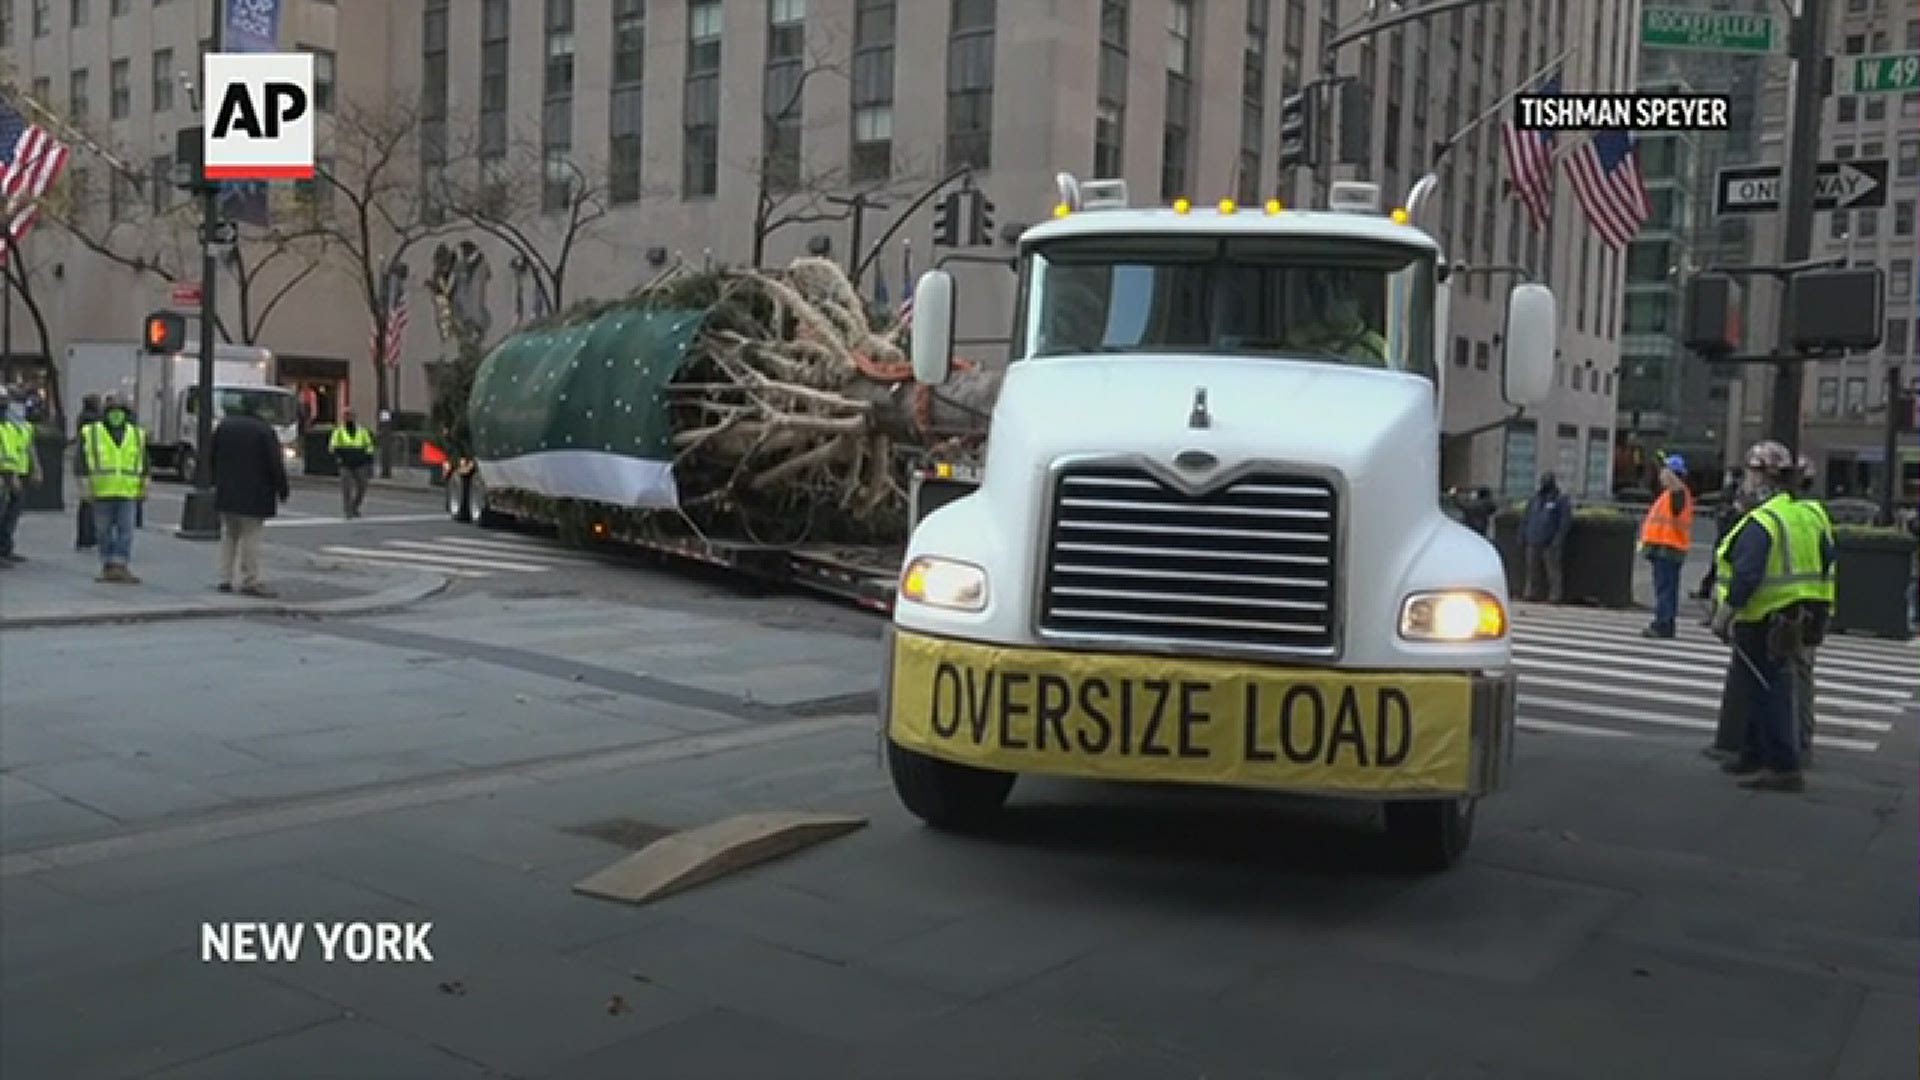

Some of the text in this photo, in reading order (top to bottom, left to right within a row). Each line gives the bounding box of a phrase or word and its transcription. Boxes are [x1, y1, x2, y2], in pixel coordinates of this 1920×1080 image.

[1648, 11, 1766, 38] ROCKEFELLER
[1861, 60, 1880, 90] W
[931, 661, 1412, 768] OVERSIZE LOAD
